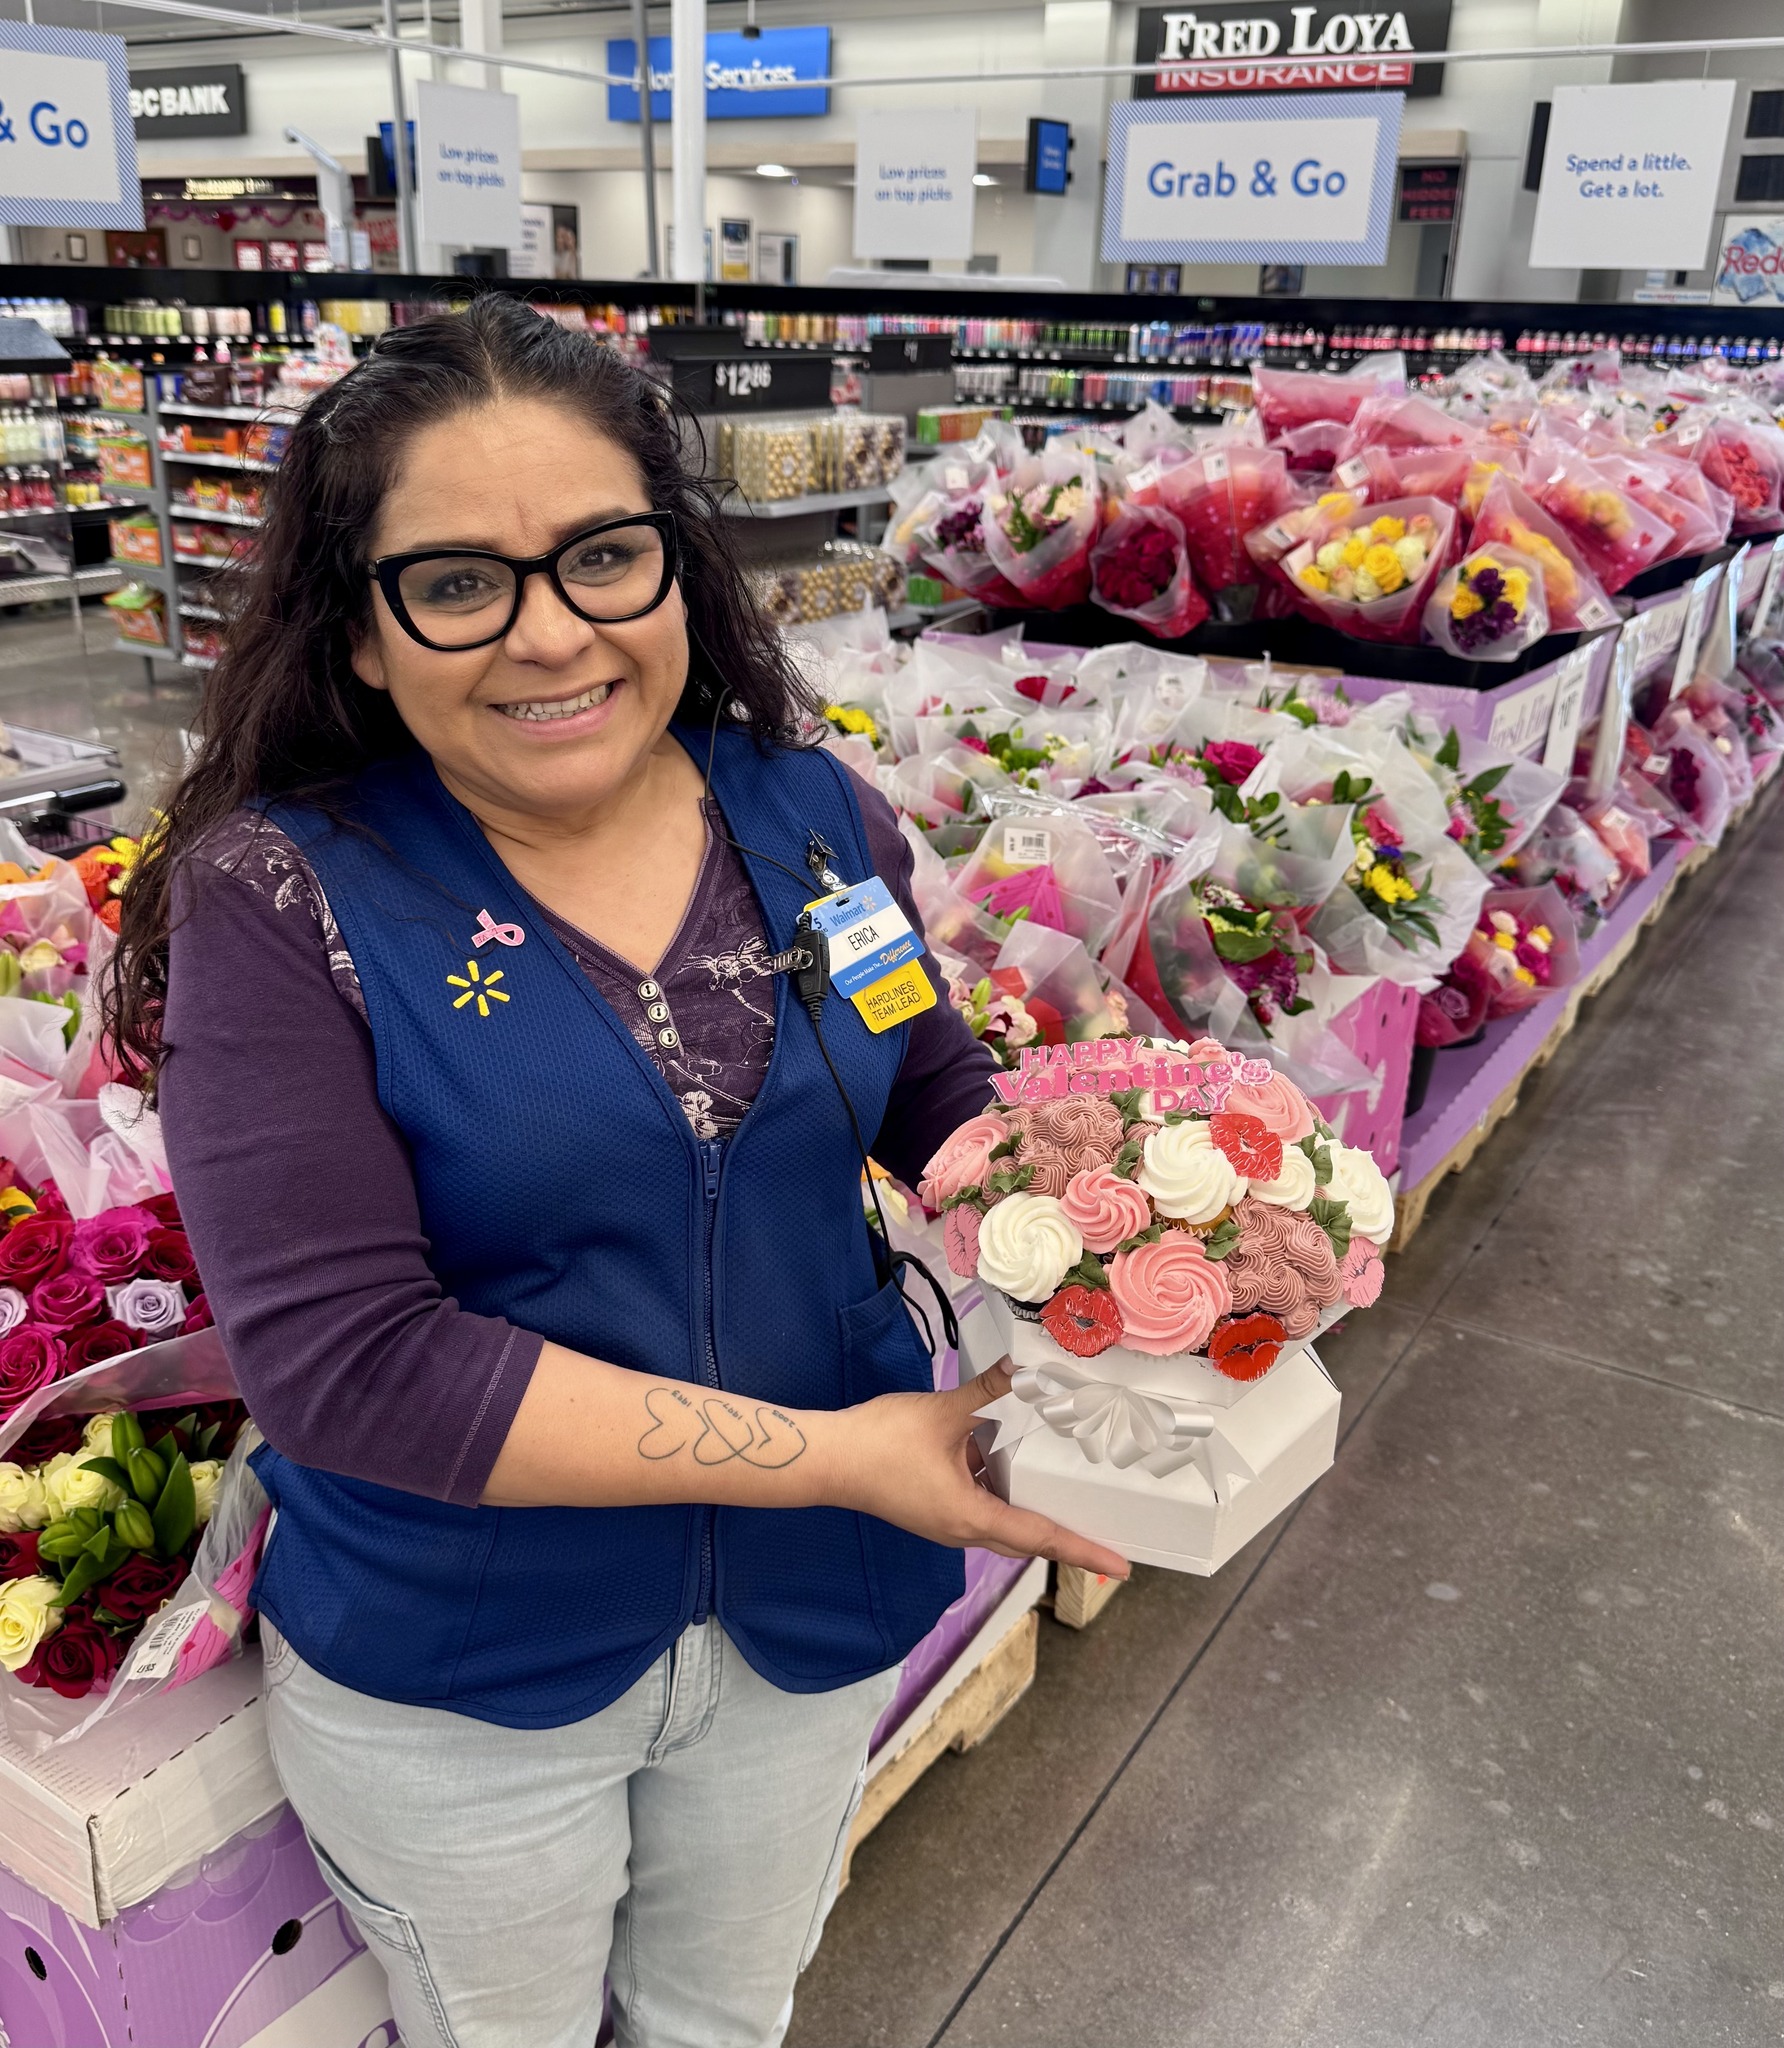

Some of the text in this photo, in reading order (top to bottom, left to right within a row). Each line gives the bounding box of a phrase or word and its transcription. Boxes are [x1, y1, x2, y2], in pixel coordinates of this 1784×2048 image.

[1159, 7, 1414, 60] FRED LOYA
[704, 59, 797, 91] Services
[1160, 60, 1406, 89] INSURANCE
[160, 84, 230, 116] BANK
[29, 101, 89, 149] Go
[438, 143, 500, 165] Low prices
[1566, 152, 1692, 176] Spend a little.
[477, 172, 506, 189] picks
[879, 163, 947, 182] Low prices
[1148, 159, 1347, 198] Grab & Go
[918, 185, 953, 204] picks
[1579, 179, 1665, 198] Get a lot.
[813, 917, 823, 930] 5
[829, 902, 867, 928] Walmart
[847, 924, 880, 951] ERICA
[879, 939, 913, 967] Difference
[865, 980, 917, 1011] HARDLINES
[871, 994, 922, 1023] TEAM LEAD
[1020, 1036, 1146, 1071] HAPPY
[988, 1051, 1274, 1106] Valentine's
[1151, 1082, 1234, 1114] DAY
[721, 1402, 744, 1421] 1997
